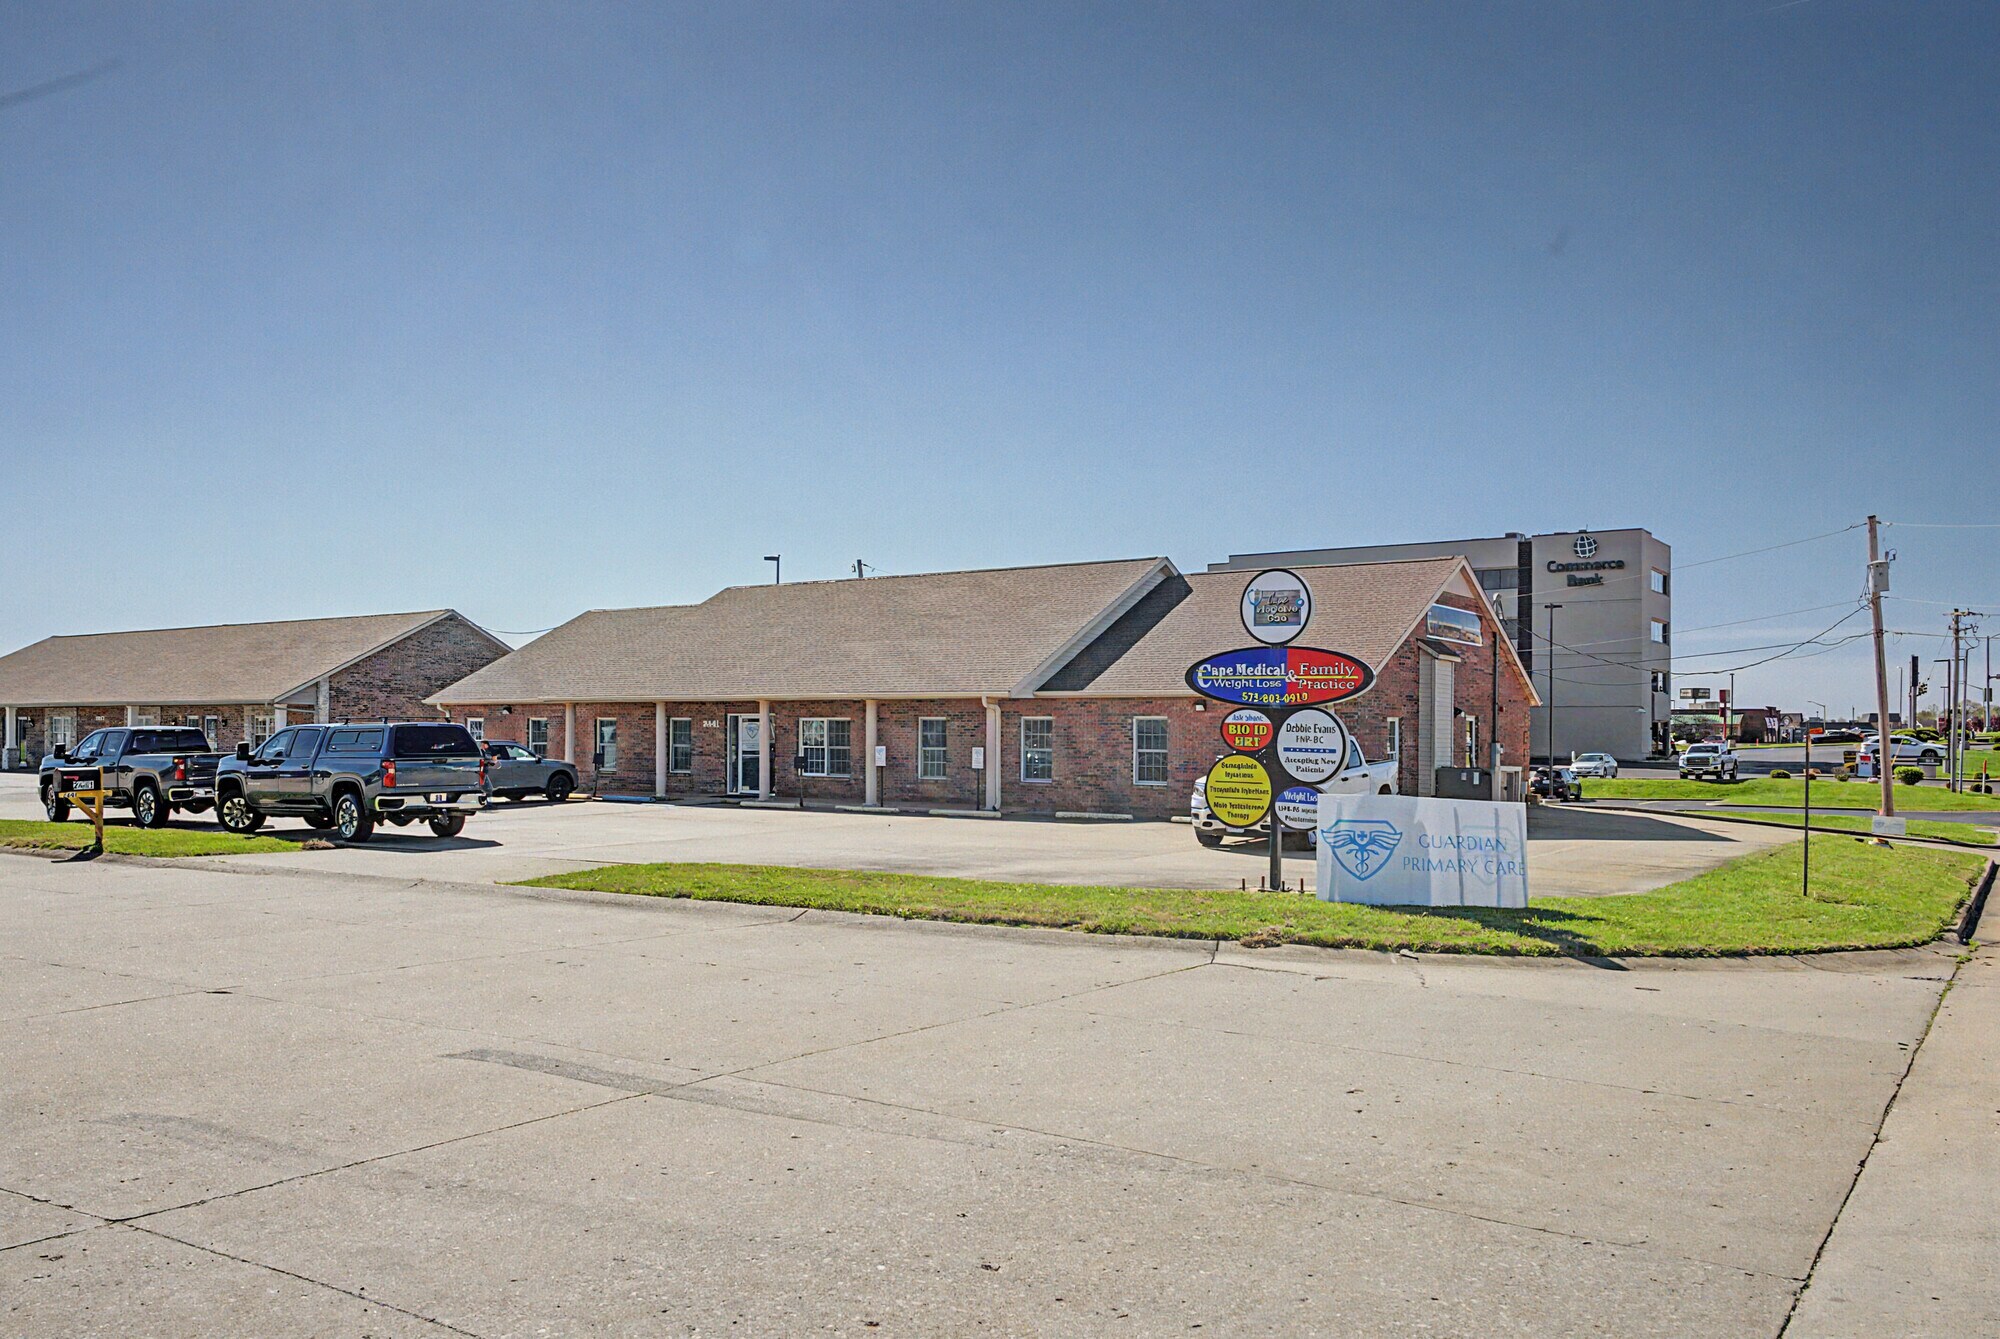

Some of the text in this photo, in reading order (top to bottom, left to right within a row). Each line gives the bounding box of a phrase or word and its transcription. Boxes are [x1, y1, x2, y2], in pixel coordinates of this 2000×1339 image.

[1546, 560, 1625, 573] Commerce
[1566, 573, 1604, 587] Bank
[1196, 663, 1287, 688] Cape Medical
[1299, 662, 1356, 677] Family
[1213, 679, 1282, 690] Weight Loss
[1297, 679, 1355, 689] Practice
[1228, 724, 1267, 735] BIO ID
[1286, 723, 1337, 734] Debbie Evans
[1284, 756, 1320, 765] Accepting
[1296, 765, 1325, 773] Patients
[1418, 834, 1507, 851] GUARDIAN
[1403, 856, 1526, 876] PRIMARY CARE
